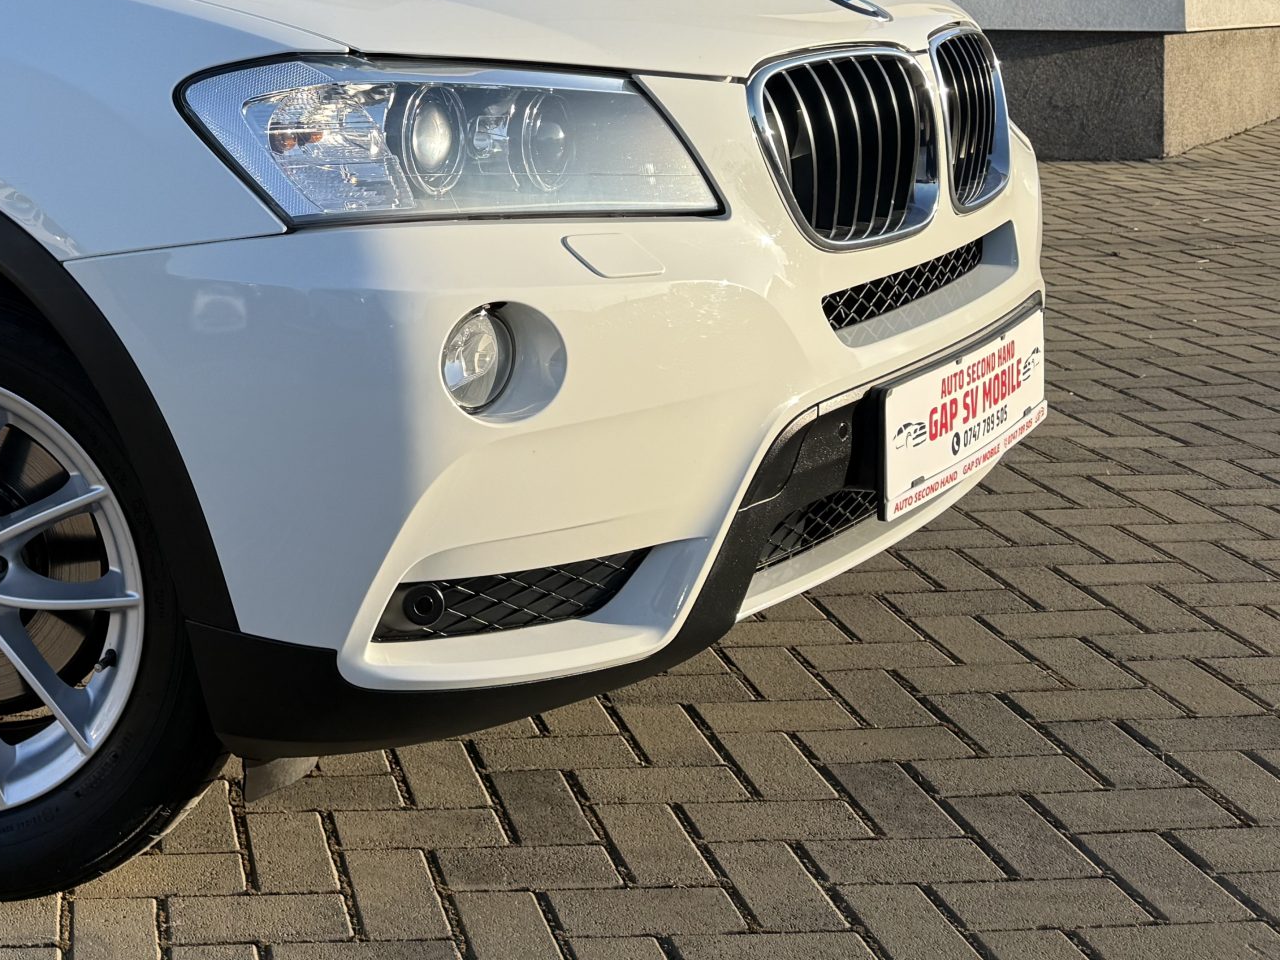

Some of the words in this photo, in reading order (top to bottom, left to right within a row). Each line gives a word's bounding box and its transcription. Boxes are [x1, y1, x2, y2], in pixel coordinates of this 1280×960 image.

[928, 397, 959, 442] GAP
[962, 385, 979, 425] SV
[982, 357, 1023, 413] MOBILE
[941, 369, 965, 400] AUTO
[966, 351, 996, 386] SECOND
[997, 339, 1016, 368] HAND
[963, 422, 981, 448] 0747
[982, 413, 995, 437] 789
[996, 404, 1008, 427] 505
[893, 495, 914, 514] AUTO
[914, 481, 940, 503] SECOND
[939, 470, 958, 489] HAND
[962, 460, 975, 475] GAP
[974, 454, 983, 468] SV
[982, 443, 1001, 464] MOBILE
